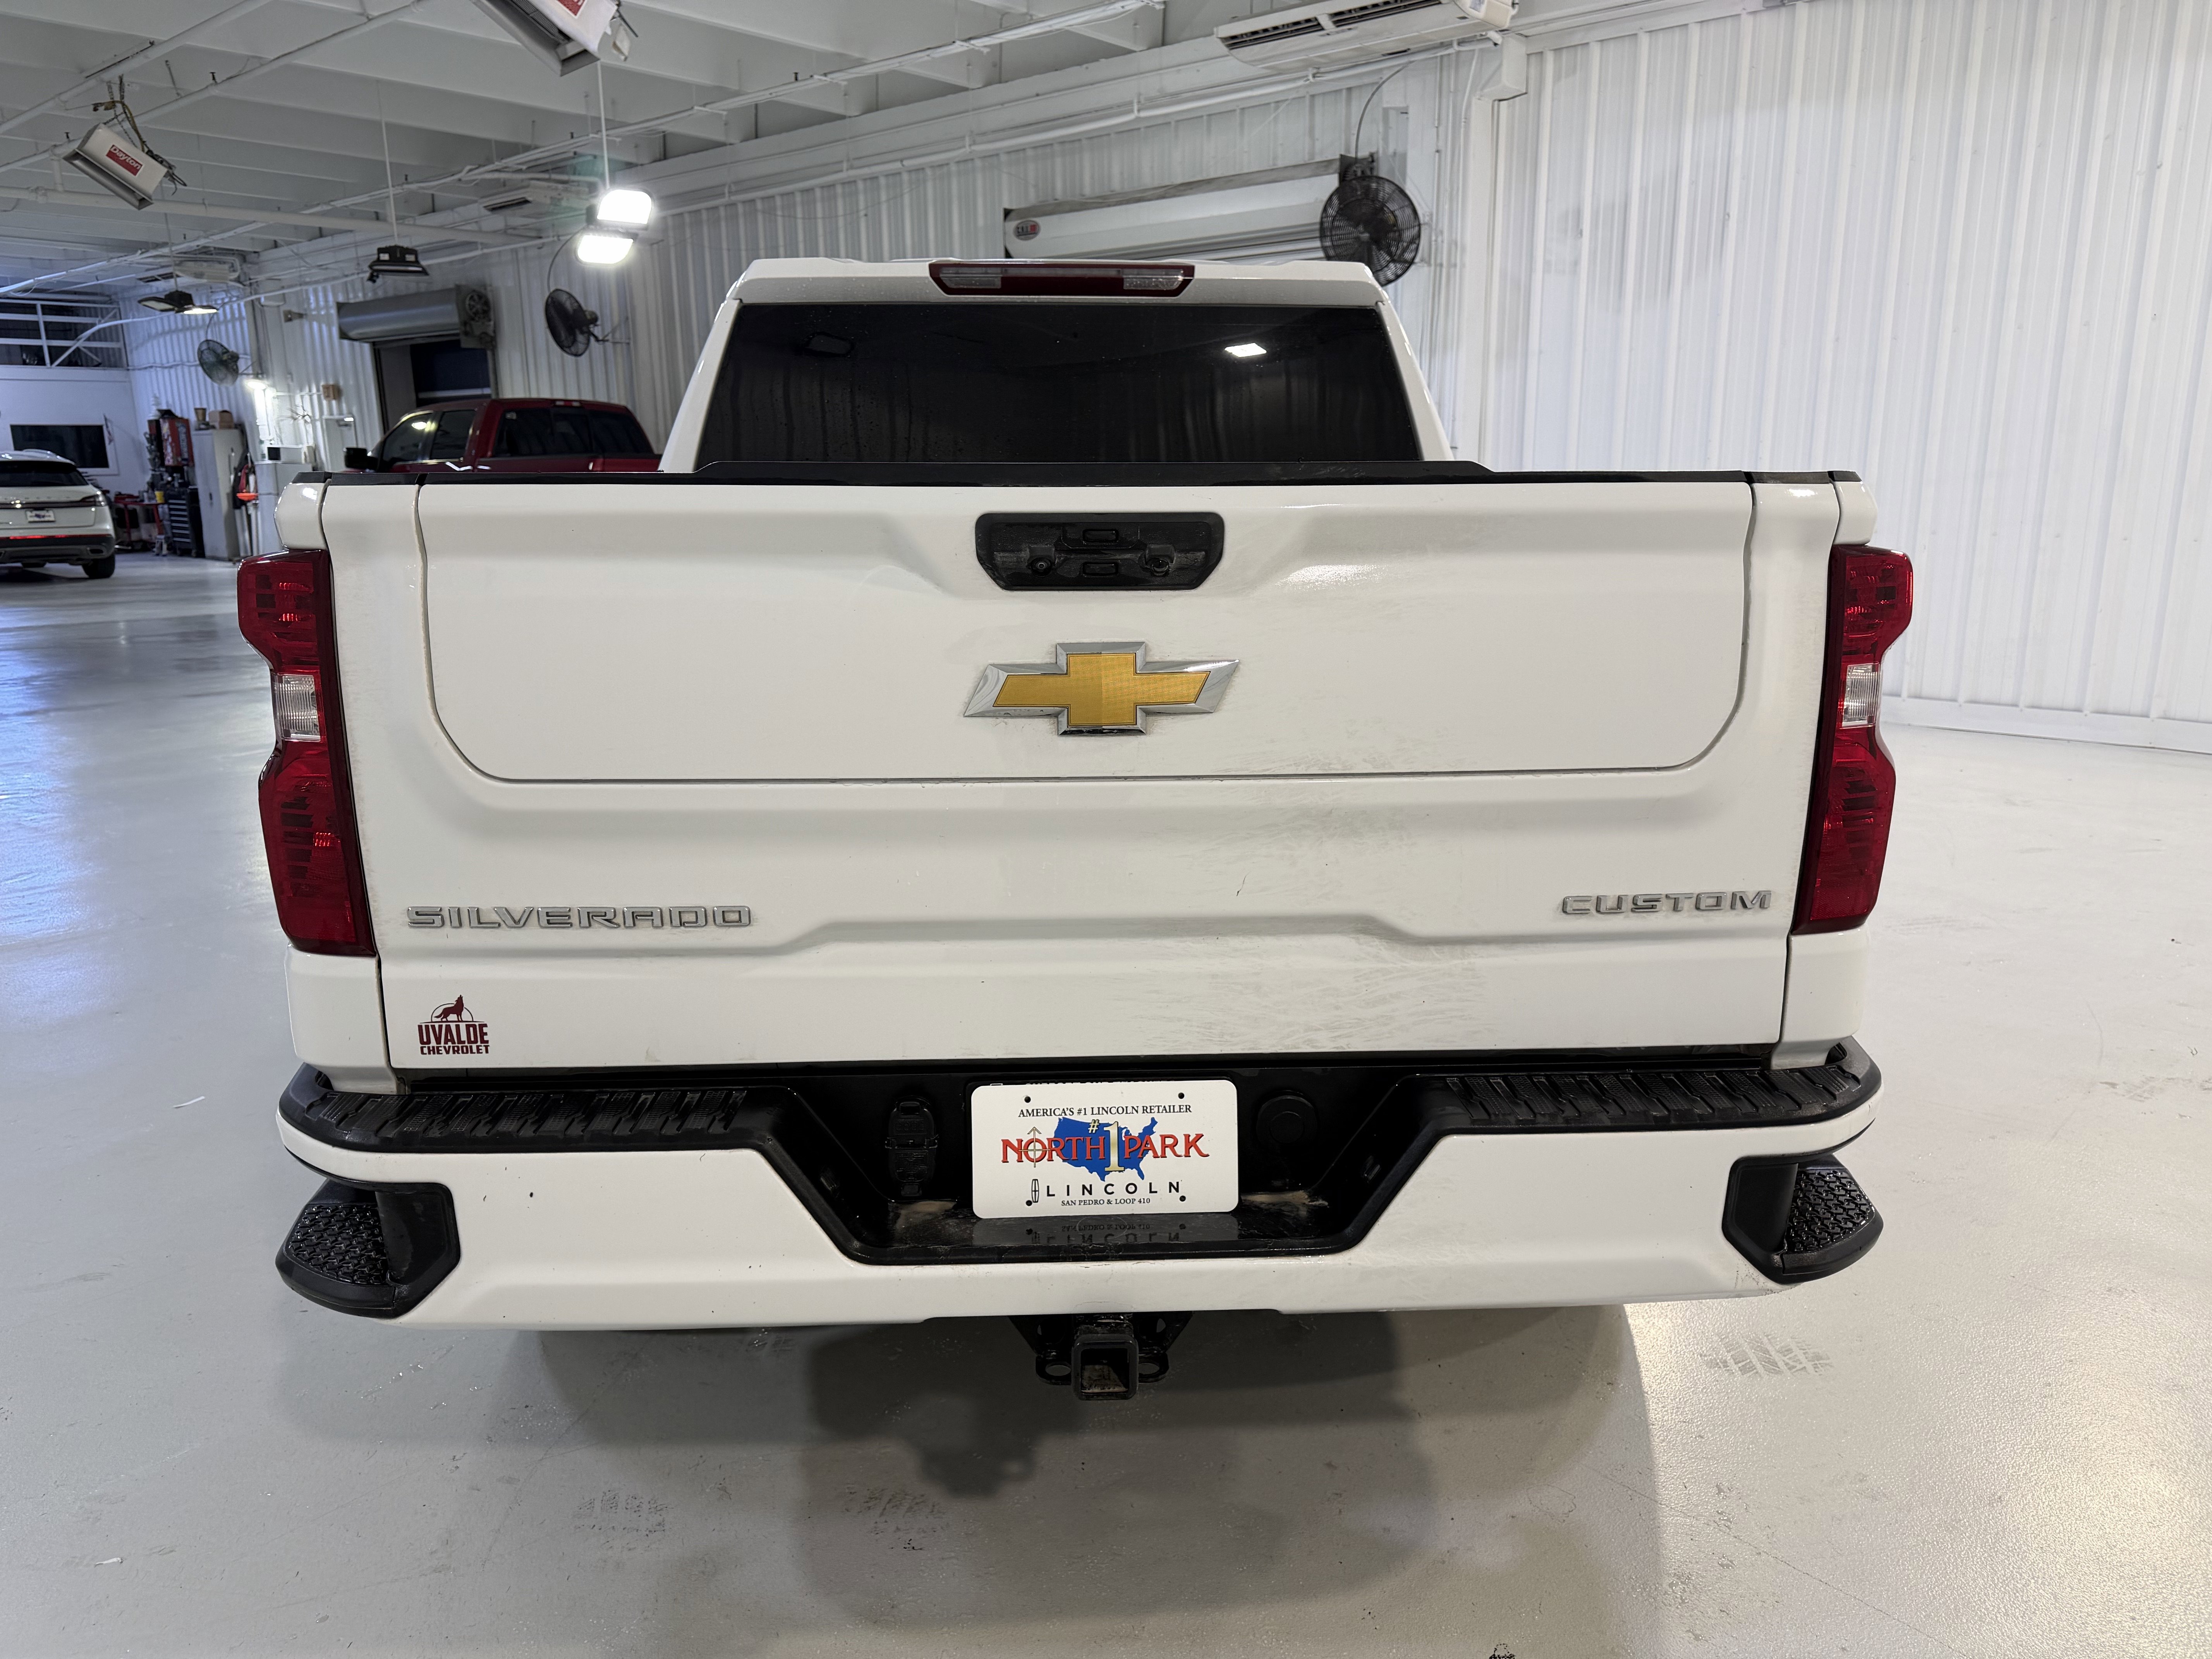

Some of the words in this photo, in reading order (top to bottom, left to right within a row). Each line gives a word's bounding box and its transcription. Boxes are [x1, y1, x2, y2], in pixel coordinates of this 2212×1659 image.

[110, 146, 141, 170] Dayton
[1562, 890, 1772, 914] CUSTOM
[407, 905, 752, 928] SILVERADO
[417, 1023, 489, 1045] UVALDE
[420, 1045, 490, 1055] CHEVROLET
[1018, 1108, 1075, 1118] AMERICA'S
[1077, 1108, 1087, 1116] #1
[1091, 1106, 1139, 1115] LINCOLN
[1142, 1104, 1192, 1114] RETAILER
[1001, 1136, 1106, 1163] NORTH
[1123, 1133, 1210, 1159] PARK
[1047, 1182, 1180, 1197] LINCOLN
